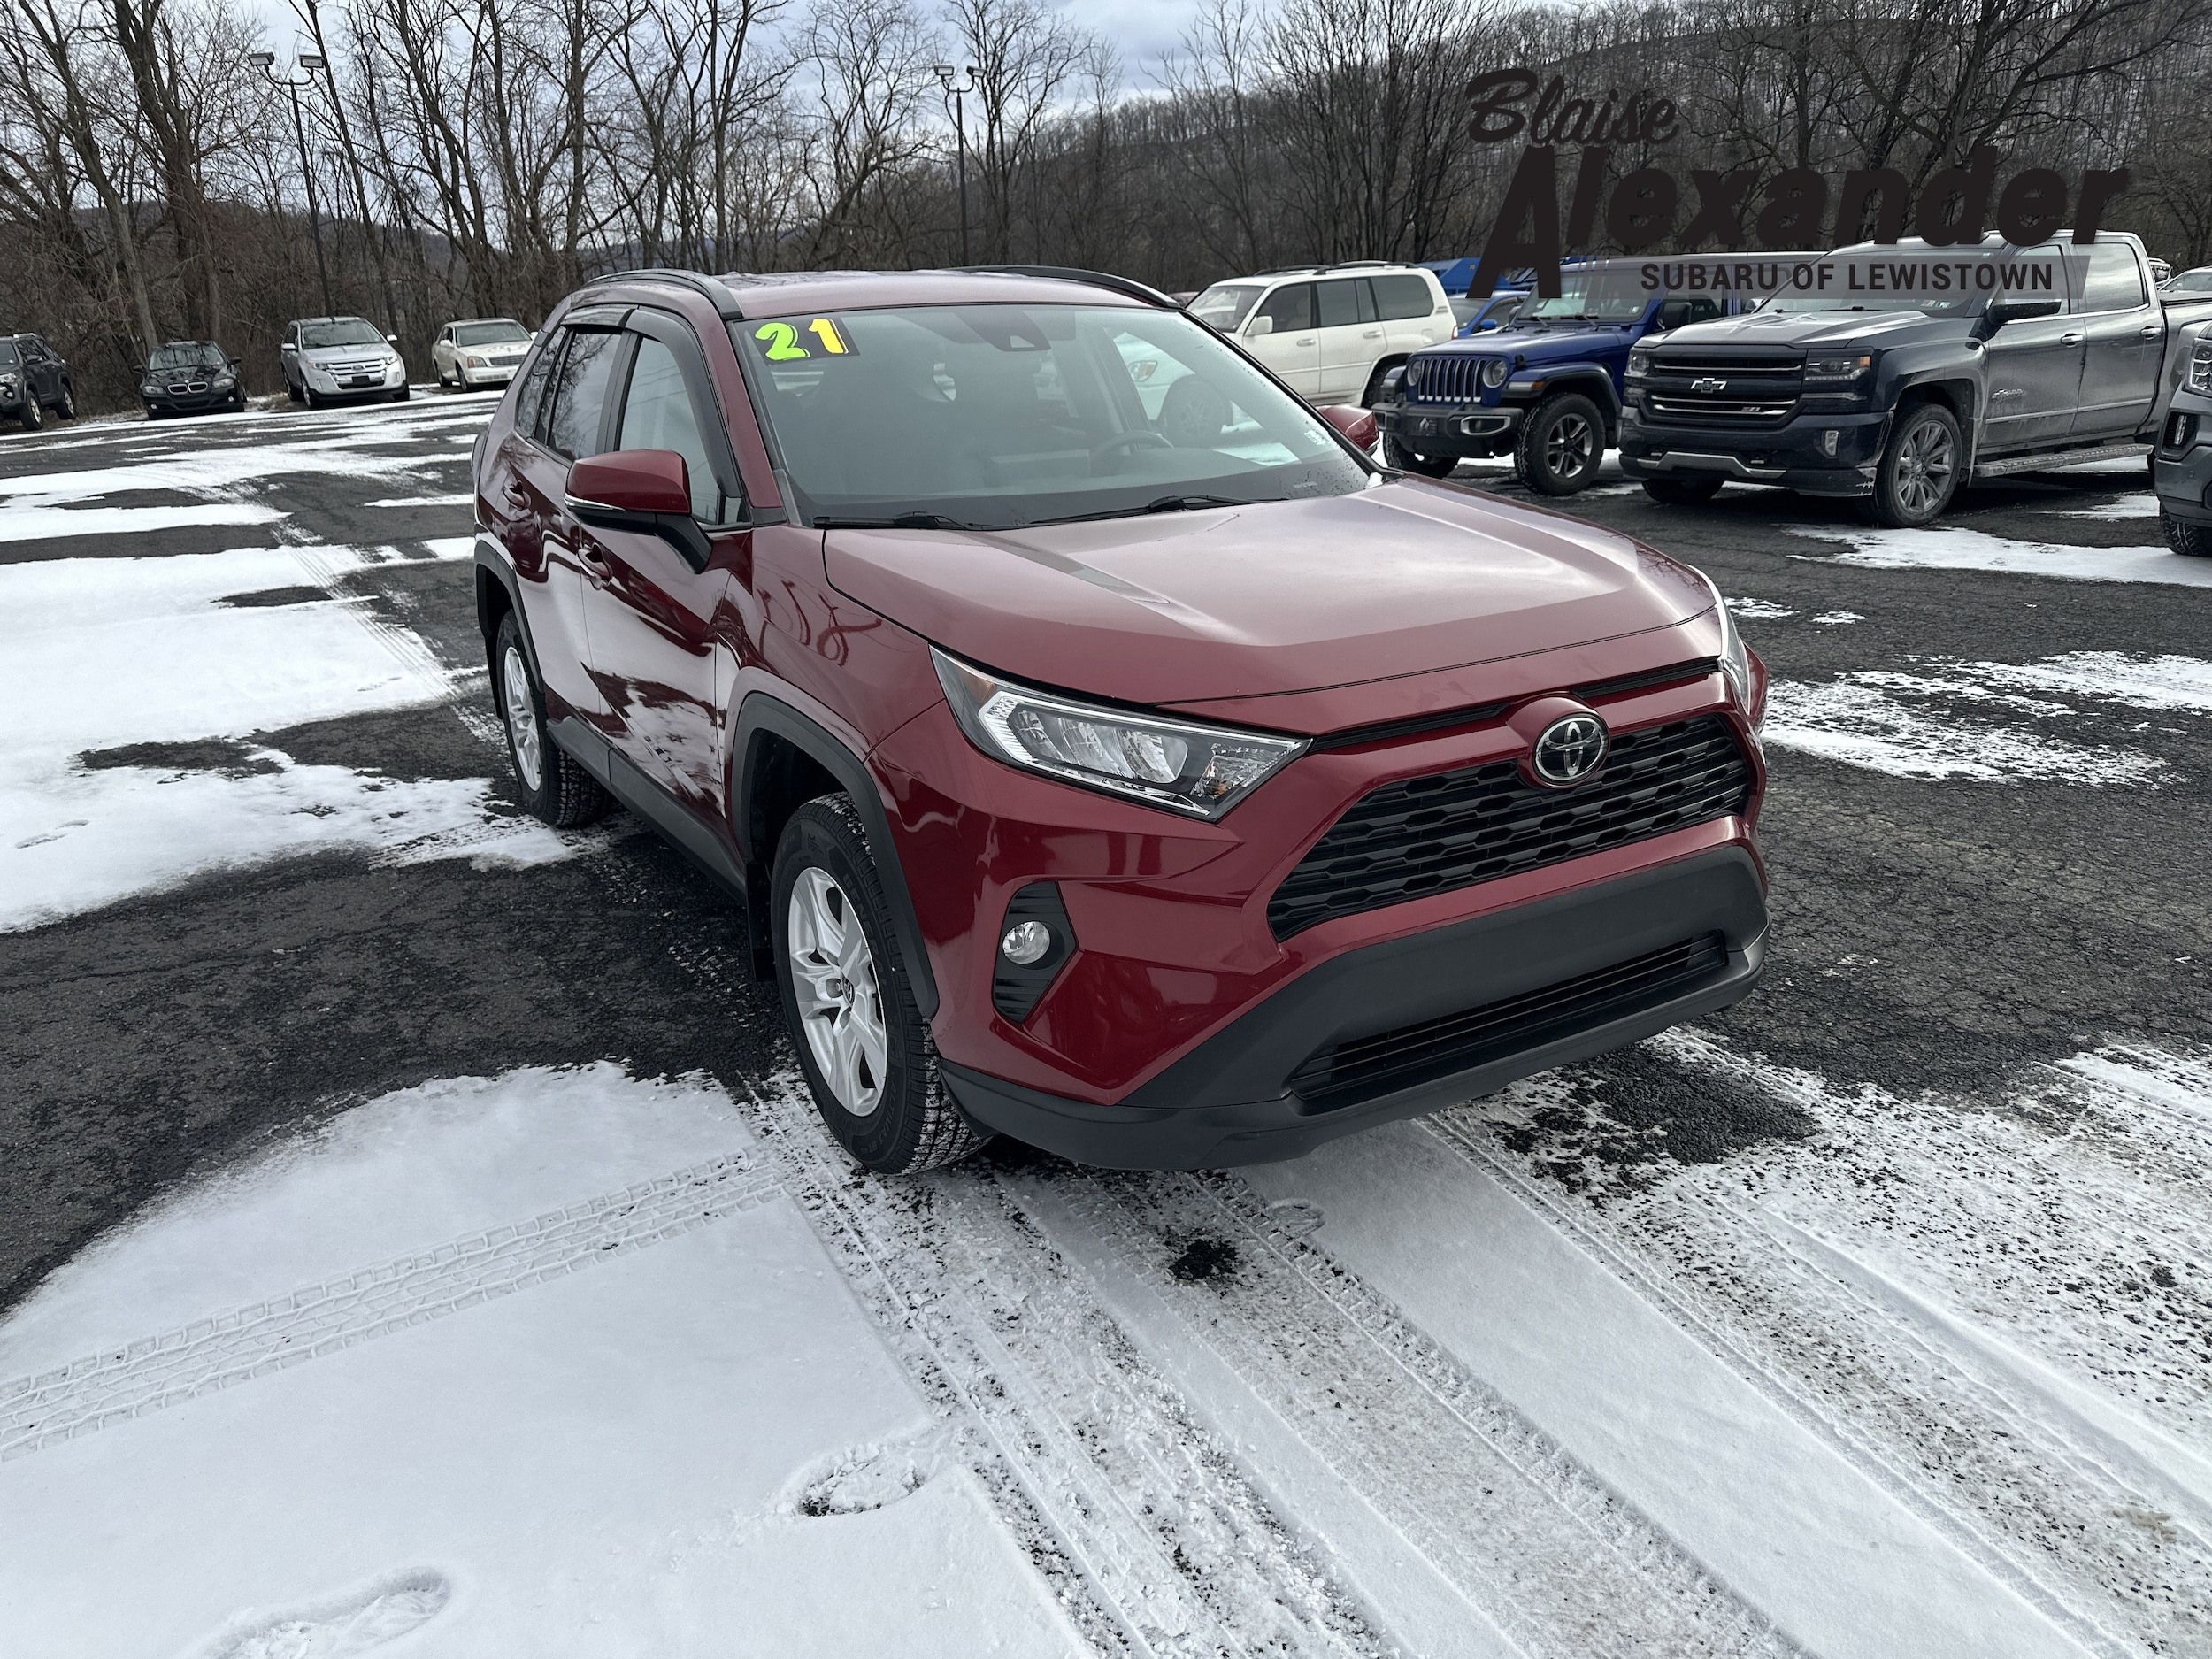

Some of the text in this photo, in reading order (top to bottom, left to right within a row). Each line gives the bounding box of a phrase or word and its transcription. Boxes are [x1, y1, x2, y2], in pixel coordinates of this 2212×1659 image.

[754, 319, 849, 361] 21
[841, 872, 887, 989] GENERAL
[878, 1078, 898, 1146] ALTIMAX
